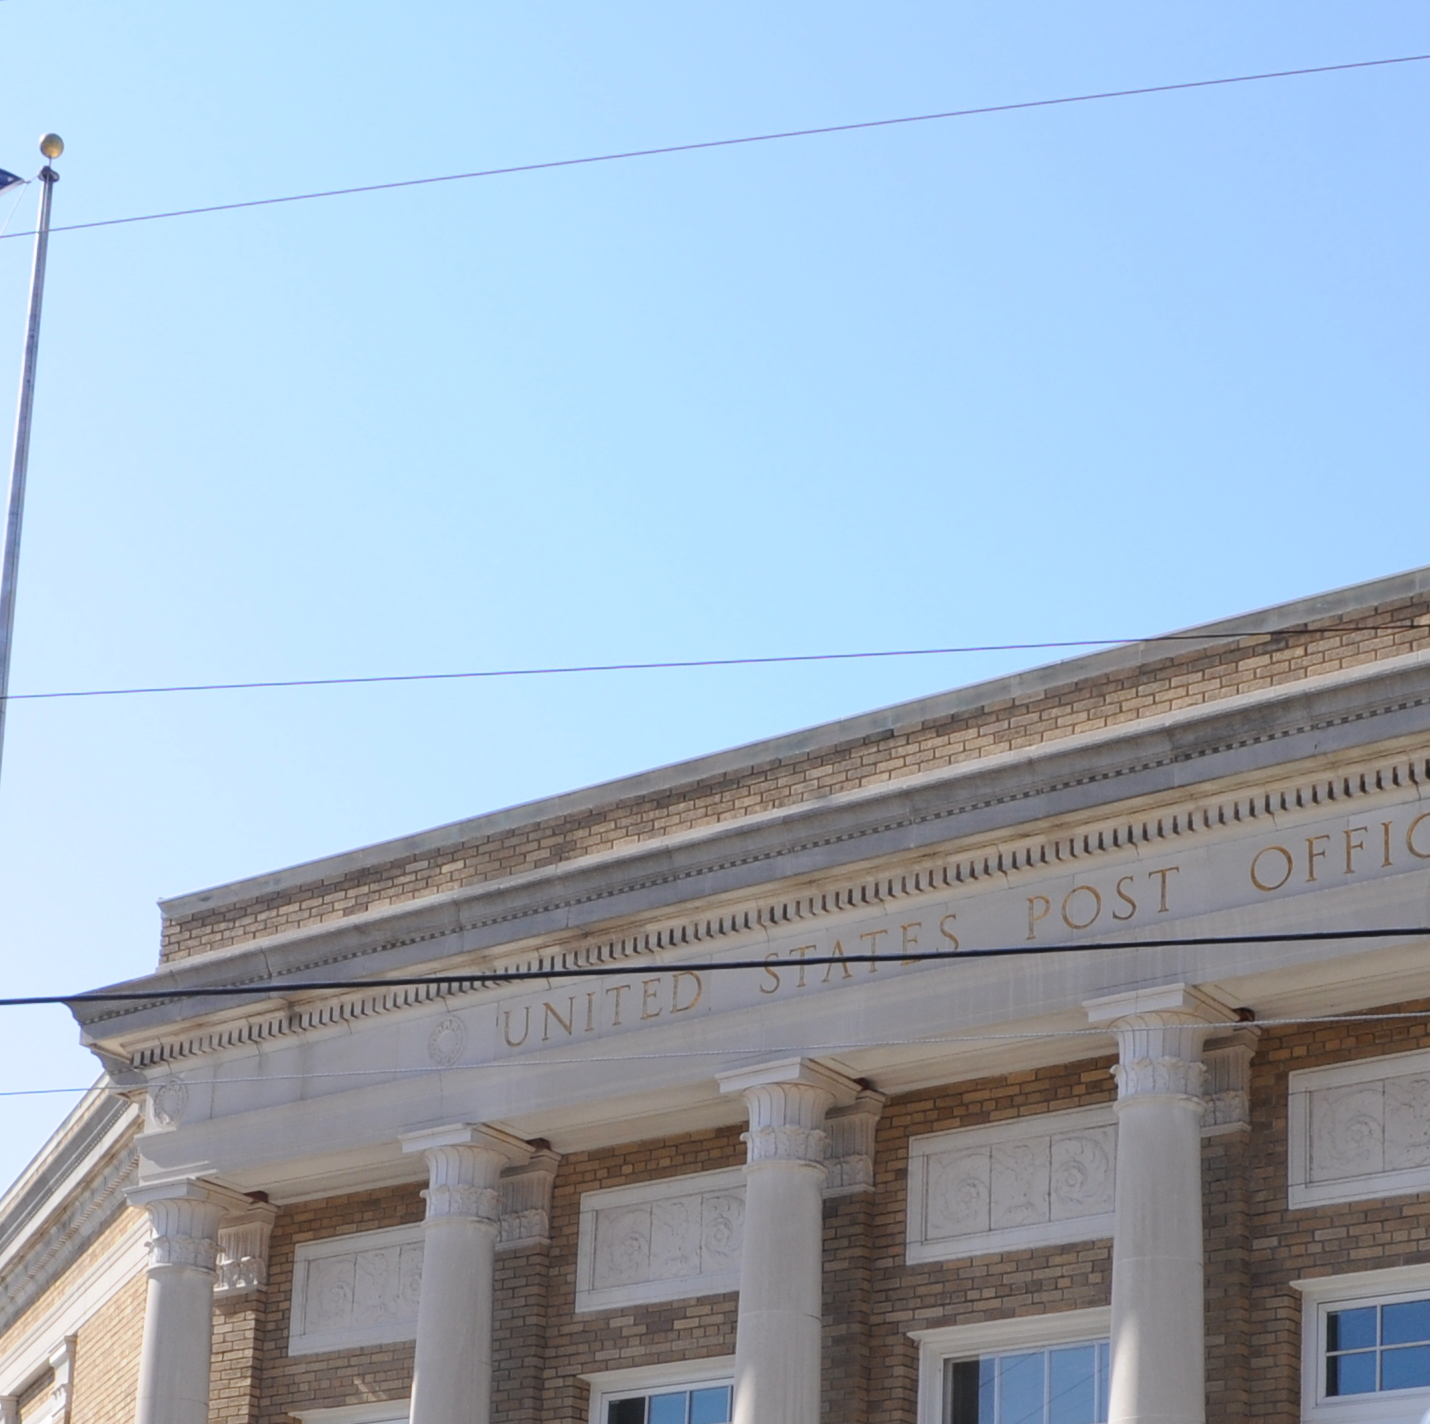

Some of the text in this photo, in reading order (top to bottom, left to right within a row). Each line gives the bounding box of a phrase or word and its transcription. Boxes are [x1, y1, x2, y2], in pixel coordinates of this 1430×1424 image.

[503, 971, 703, 1047] UNITED
[759, 913, 960, 994] STATES
[1025, 866, 1180, 941] POST
